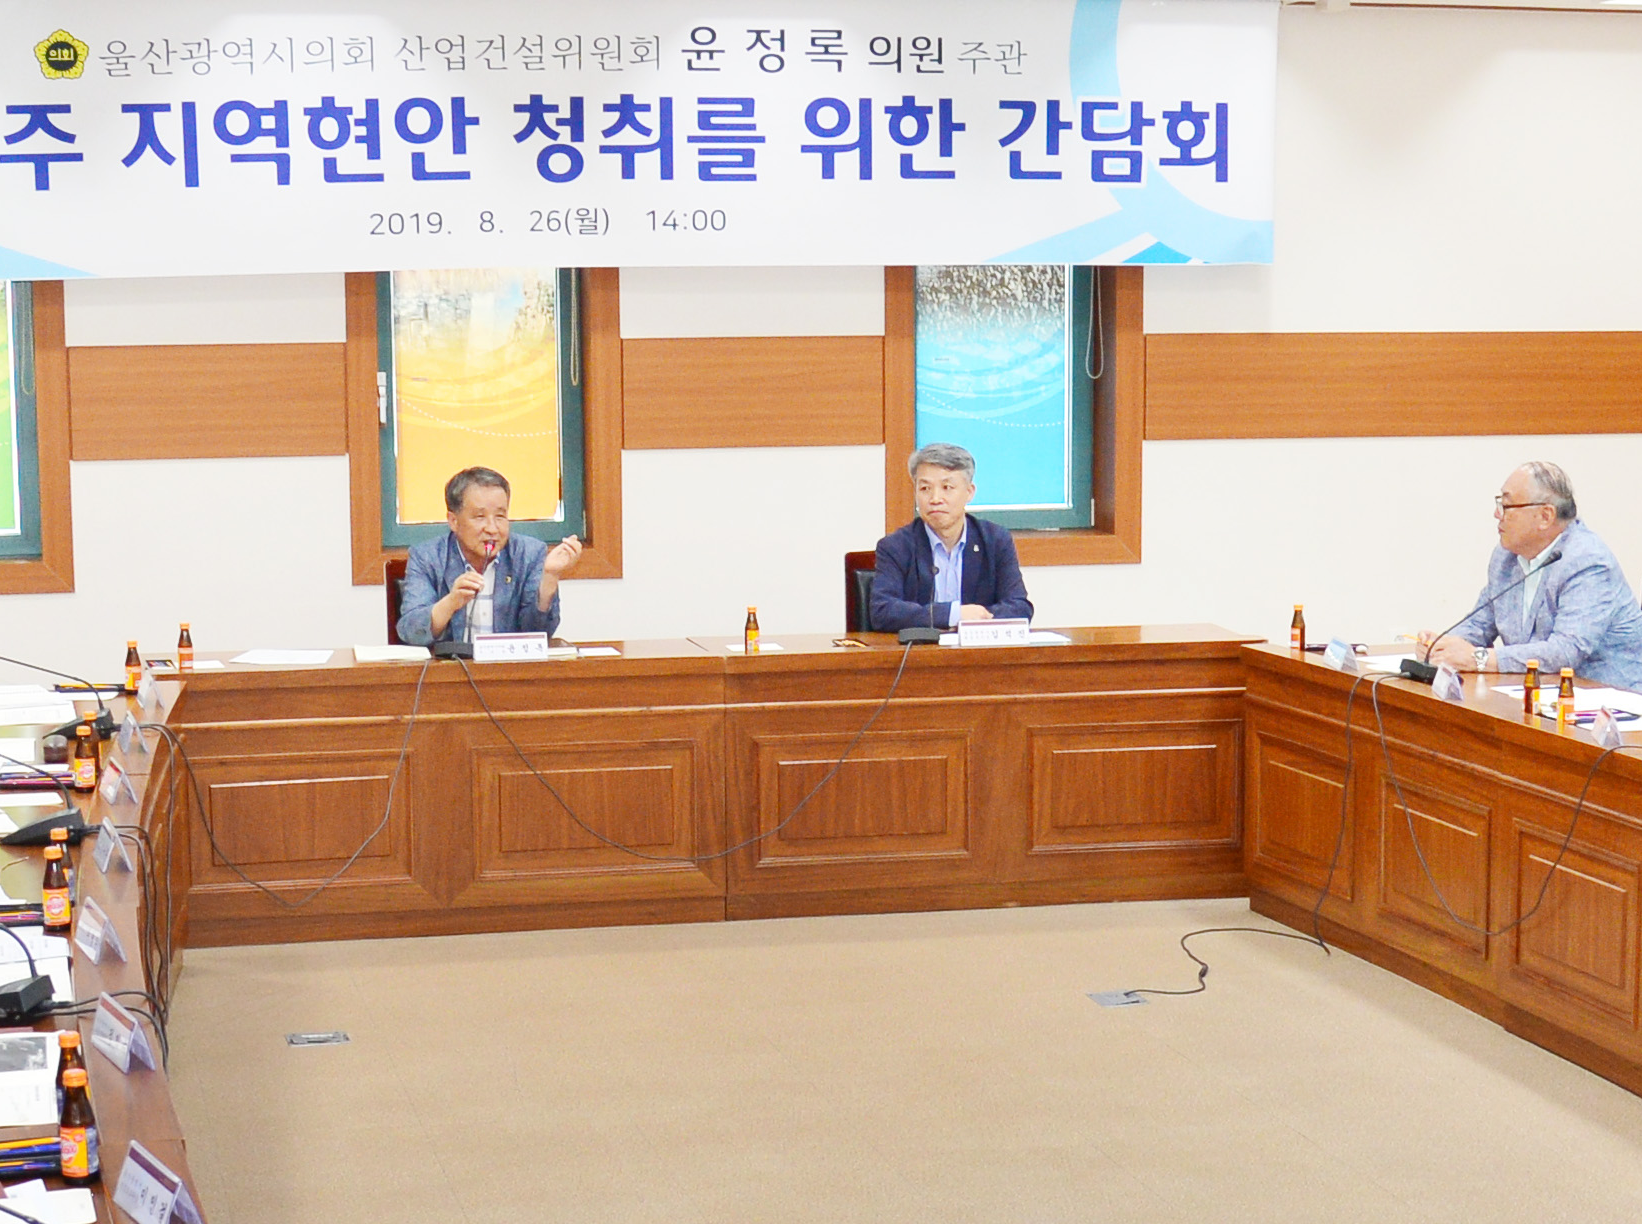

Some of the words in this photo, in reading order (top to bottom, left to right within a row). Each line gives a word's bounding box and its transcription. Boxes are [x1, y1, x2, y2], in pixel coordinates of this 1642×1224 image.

[48, 48, 75, 61] 의회
[98, 35, 376, 78] 울산광역시의회
[394, 32, 662, 73] 산업건설위원회
[868, 35, 946, 75] 의원
[957, 40, 1027, 76] 주관
[120, 95, 480, 188] 지역현안
[512, 93, 766, 183] 청취를
[800, 95, 966, 181] 위한
[998, 99, 1228, 183] 간담회
[369, 211, 453, 236] 2019.
[479, 210, 504, 235] 8.
[529, 207, 610, 236] 26(월)
[646, 208, 727, 233] 14:00
